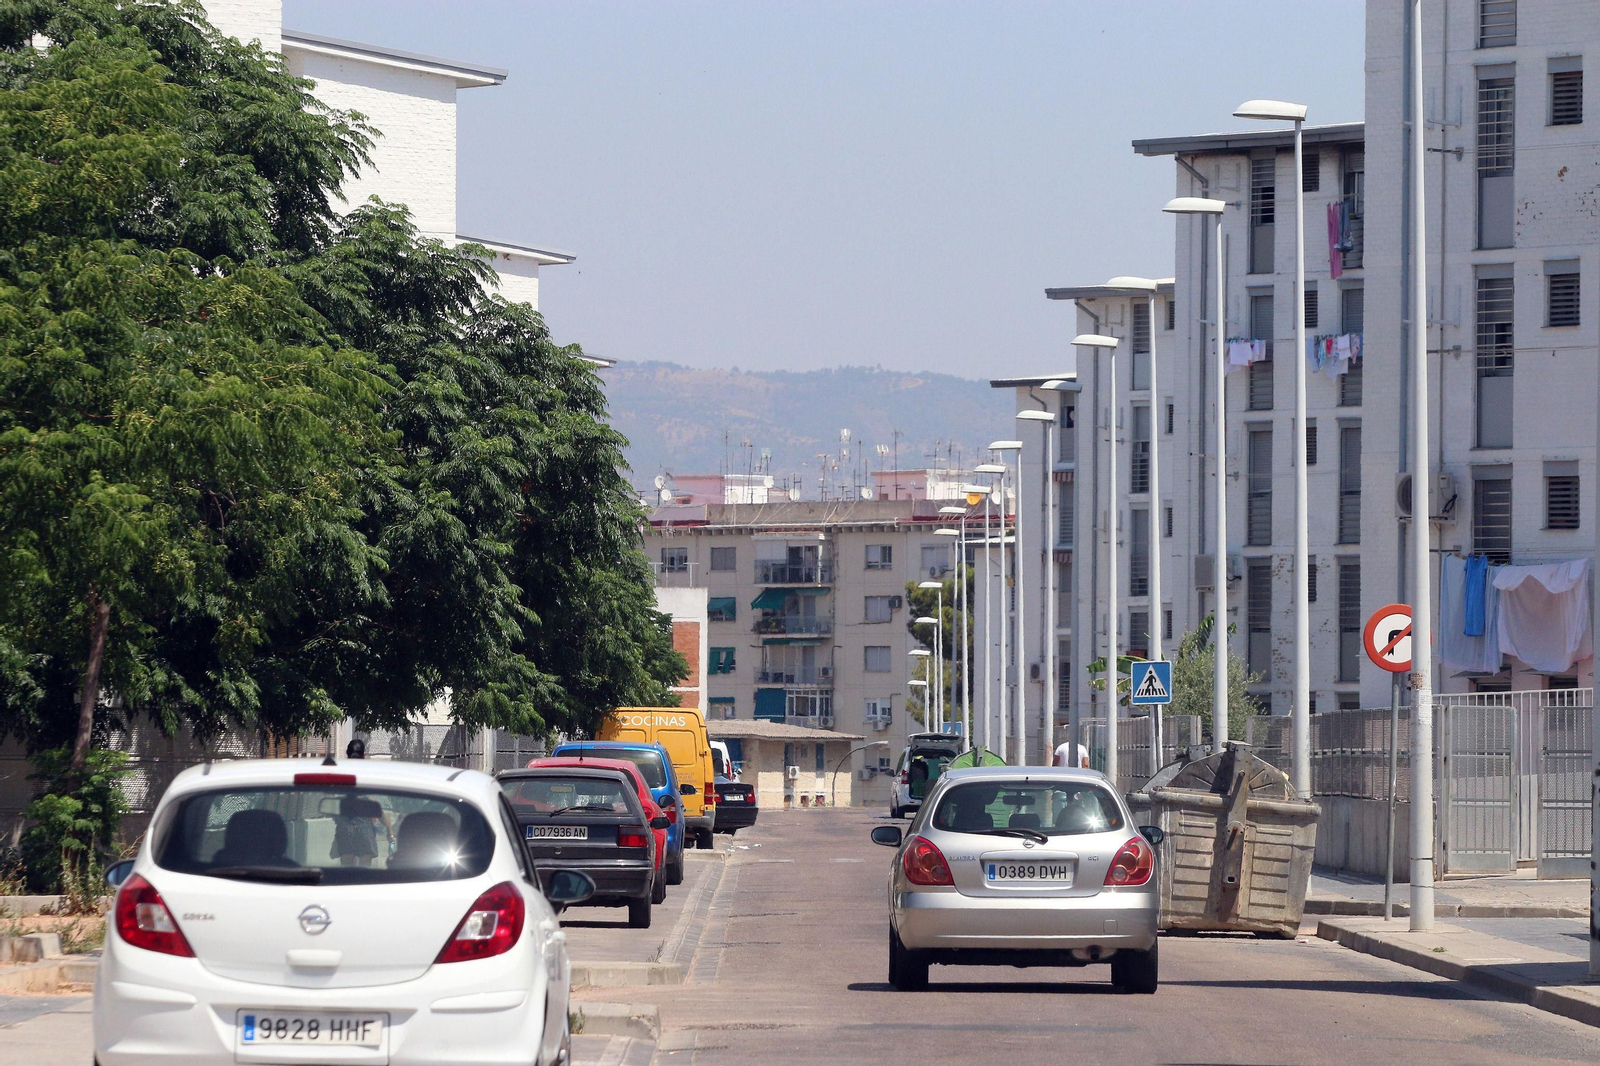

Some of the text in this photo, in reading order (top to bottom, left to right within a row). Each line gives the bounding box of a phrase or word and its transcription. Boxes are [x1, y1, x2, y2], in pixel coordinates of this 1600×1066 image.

[619, 715, 686, 727] COCINAS
[533, 827, 586, 838] CO 7936 AN
[998, 865, 1067, 880] 0389 DVH
[259, 1018, 375, 1041] 9828 HHF
